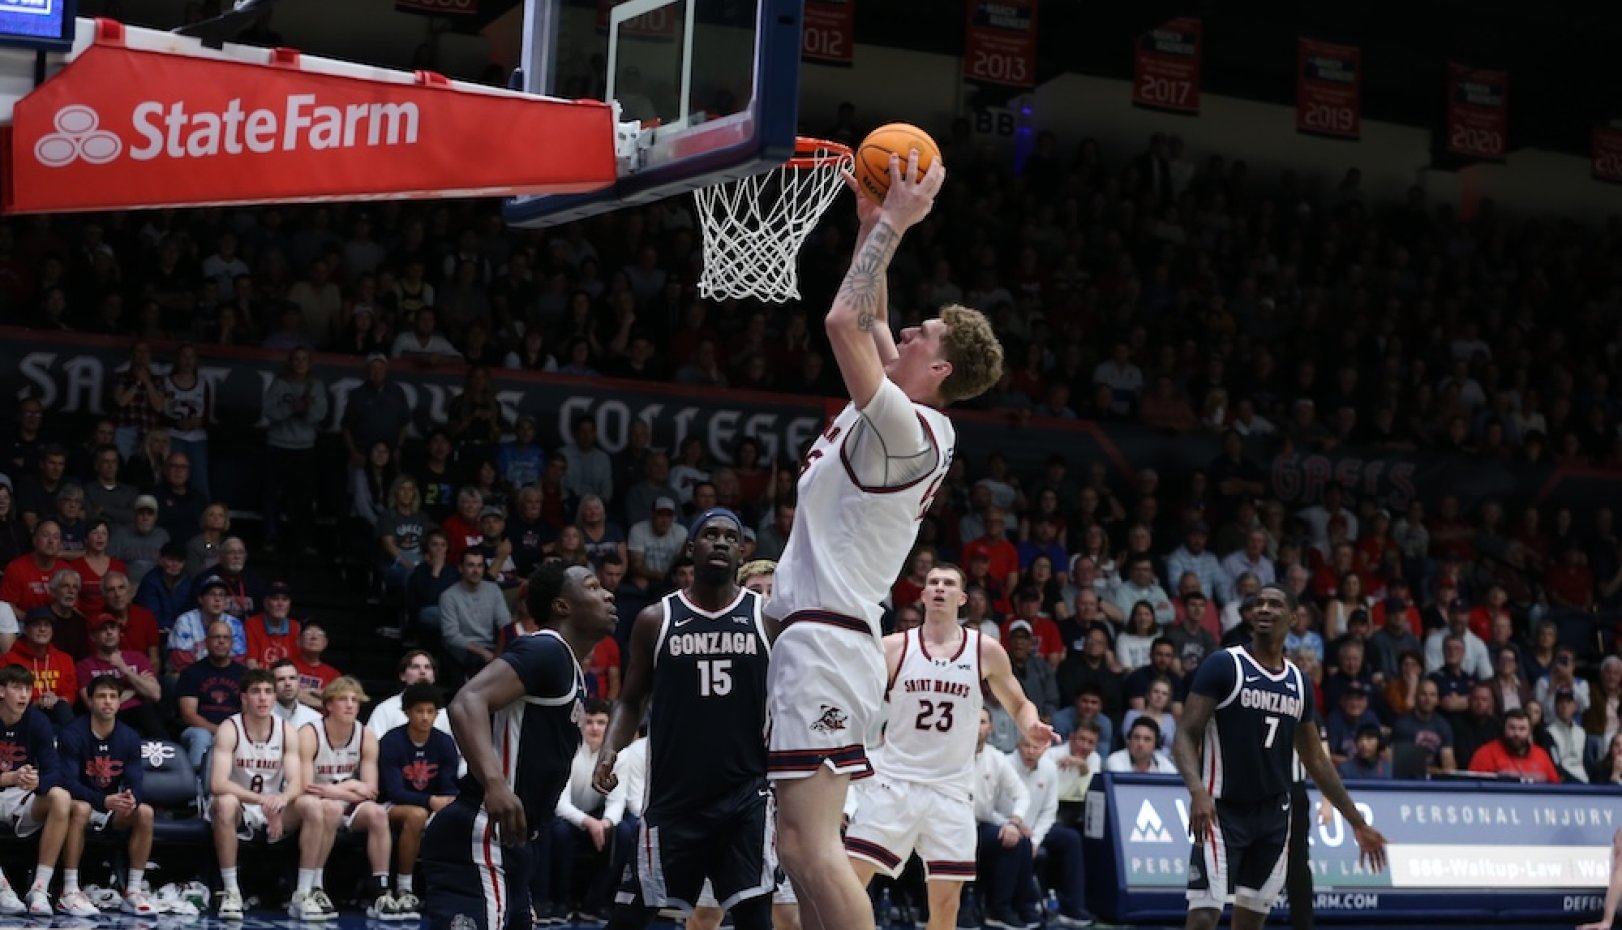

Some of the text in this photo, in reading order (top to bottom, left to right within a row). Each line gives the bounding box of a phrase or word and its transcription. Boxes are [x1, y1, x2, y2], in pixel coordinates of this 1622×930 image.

[804, 27, 843, 56] 012
[973, 50, 1026, 81] 2013
[1140, 74, 1192, 105] 2017
[1304, 102, 1354, 131] 2019
[1451, 124, 1502, 154] 2020
[669, 632, 758, 657] GONZAGA
[696, 659, 732, 697] 15
[904, 679, 932, 693] SAINT
[915, 699, 954, 733] 23
[1264, 716, 1280, 748] 7
[1400, 804, 1614, 827] PERSONAL INJURY
[1563, 895, 1606, 912] DEFEN
